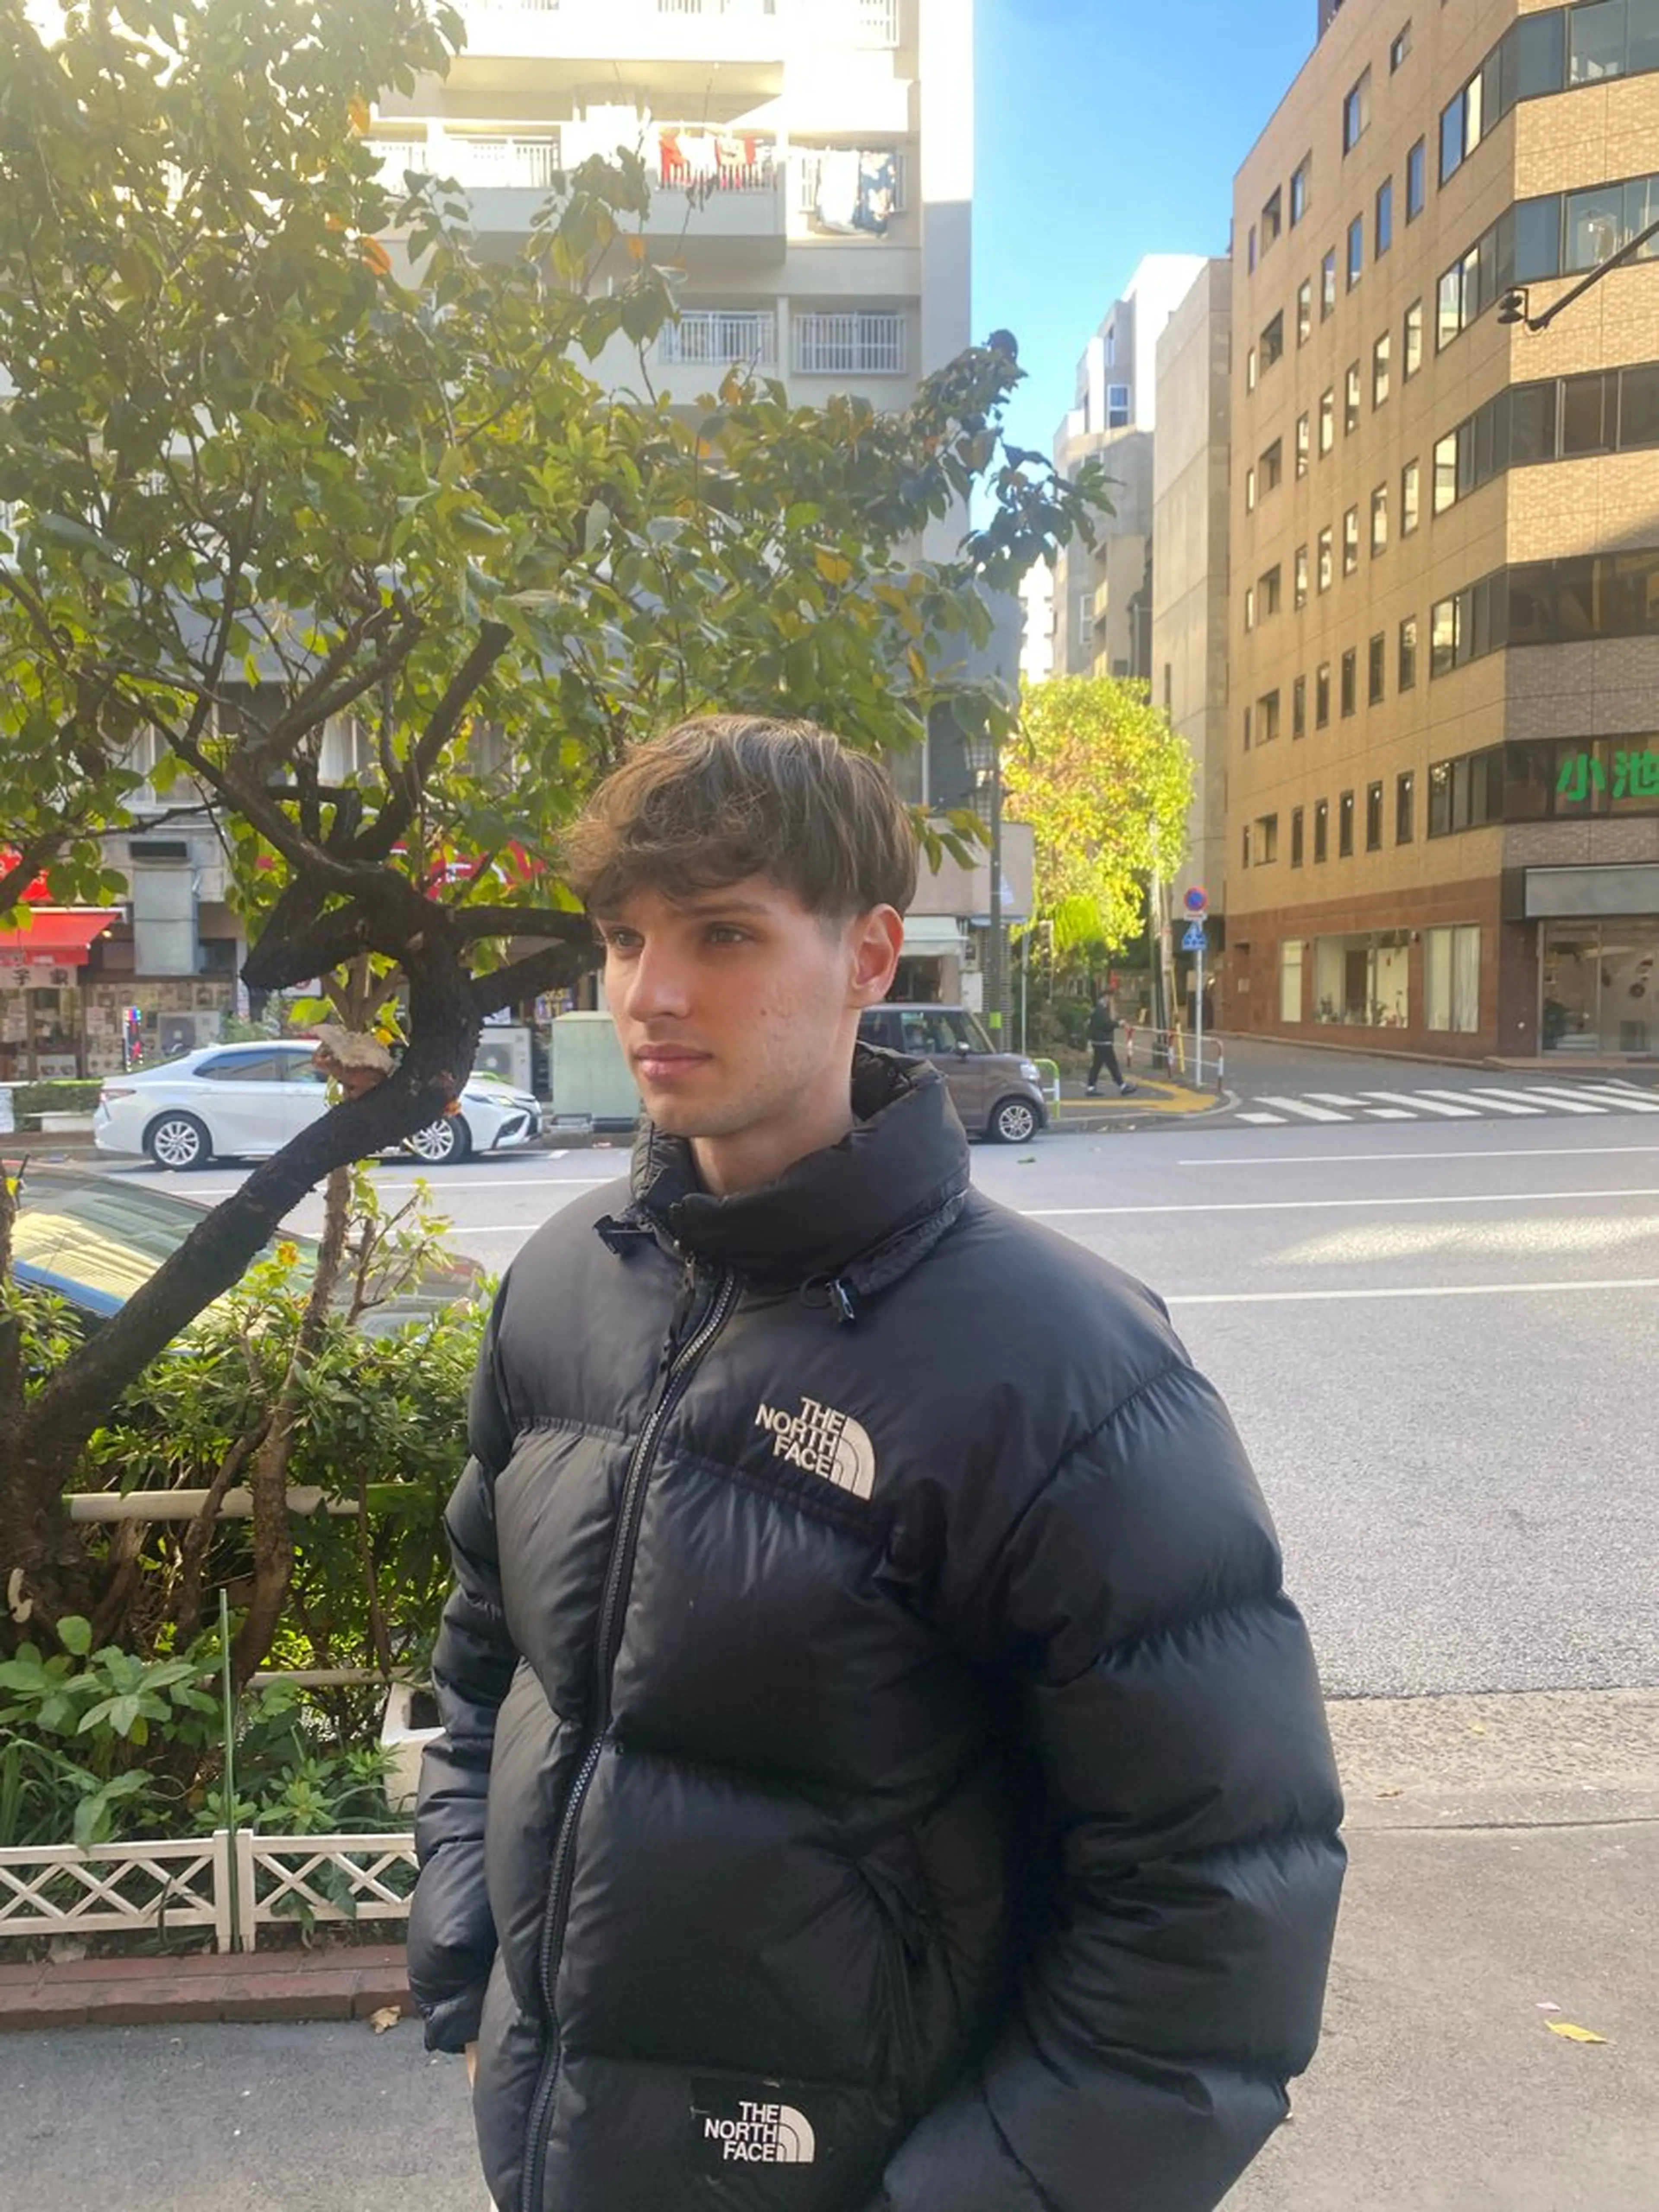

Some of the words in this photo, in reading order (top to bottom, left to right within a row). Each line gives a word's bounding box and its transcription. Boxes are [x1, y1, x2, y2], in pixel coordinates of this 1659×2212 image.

[1556, 750, 1659, 802] 小池
[755, 1403, 839, 1456] NORTH
[801, 1396, 846, 1434] THE
[773, 1435, 833, 1479] FACE
[704, 2119, 777, 2142] NORTH
[739, 2101, 779, 2123] THE
[723, 2142, 776, 2162] FACE
